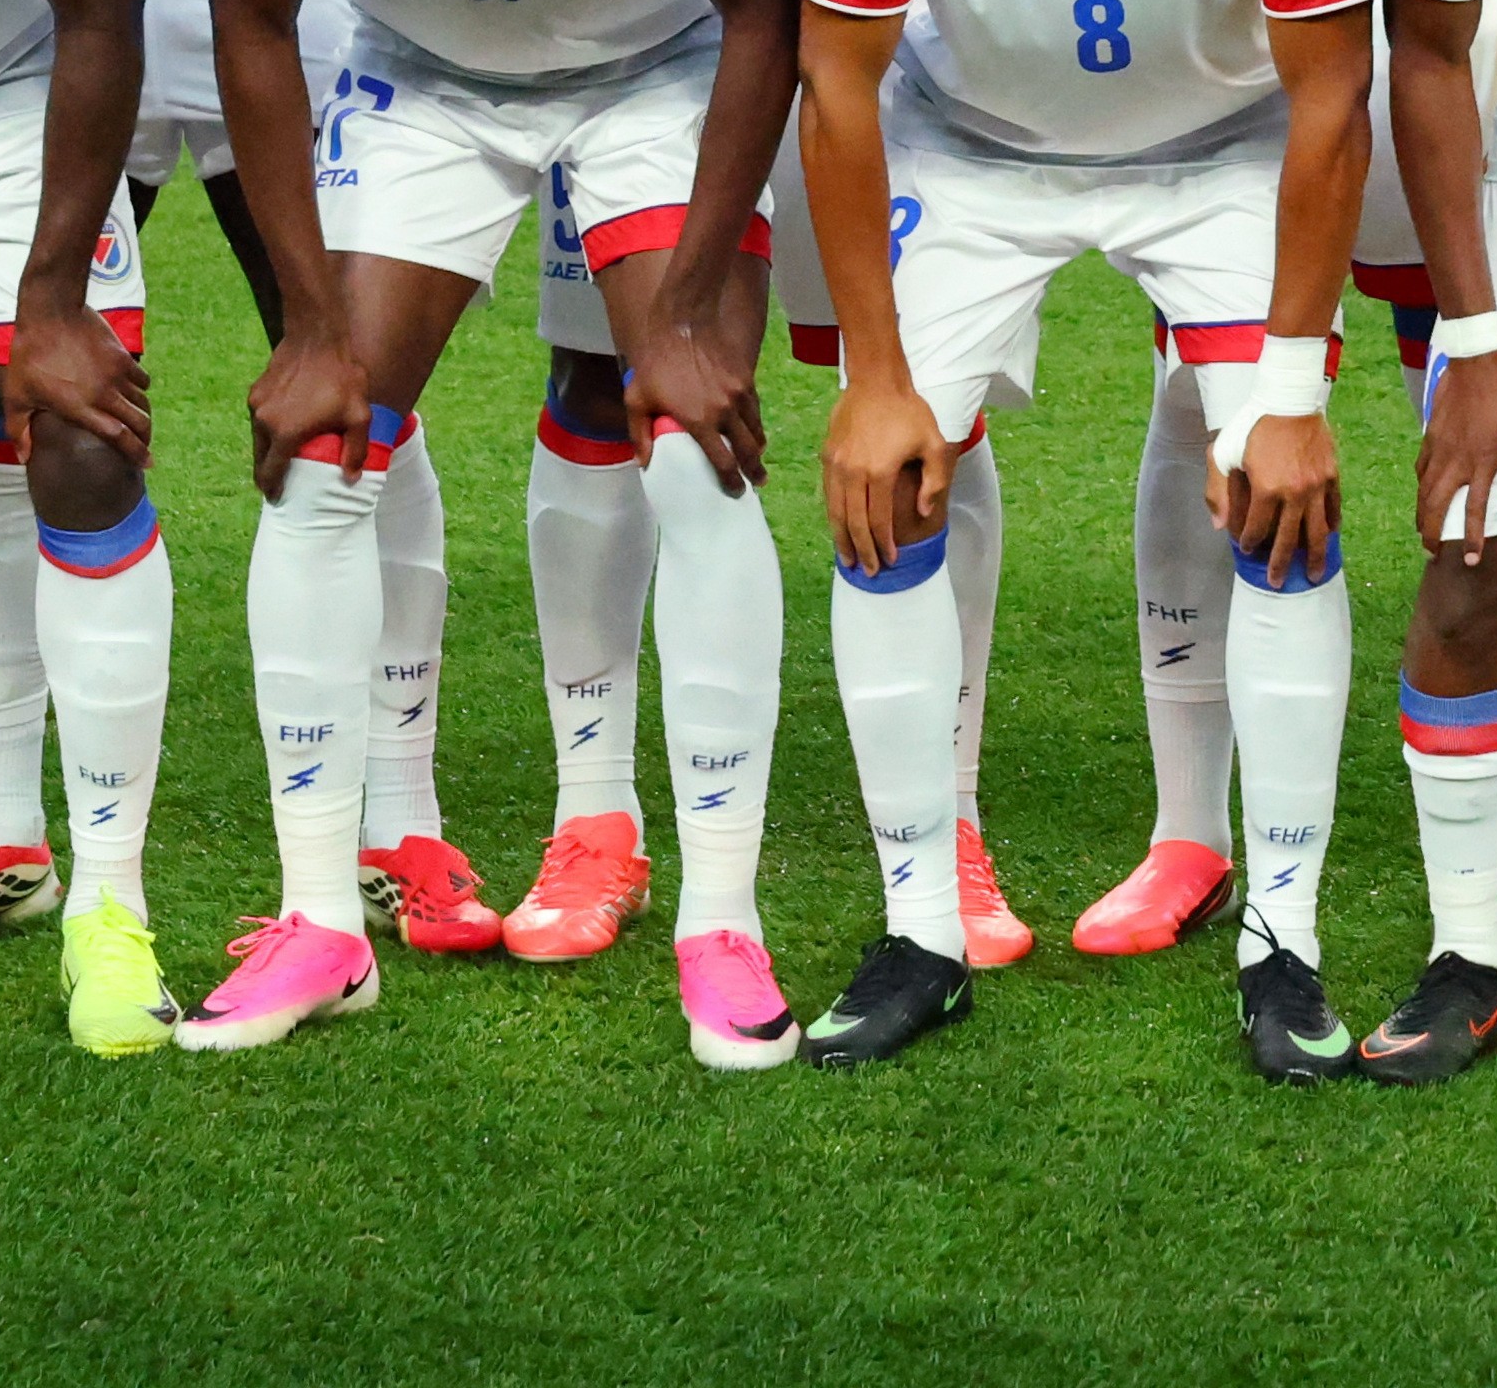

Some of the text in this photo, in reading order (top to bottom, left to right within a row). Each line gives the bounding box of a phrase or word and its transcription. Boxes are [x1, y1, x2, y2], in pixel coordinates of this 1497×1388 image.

[1146, 602, 1198, 624] FHF
[384, 662, 429, 682] FHF
[566, 682, 612, 700] FHF
[279, 723, 334, 744] FHF
[691, 751, 748, 770] FHF
[79, 765, 126, 787] FHF
[873, 824, 917, 842] FHF
[1268, 825, 1316, 843] FHF
